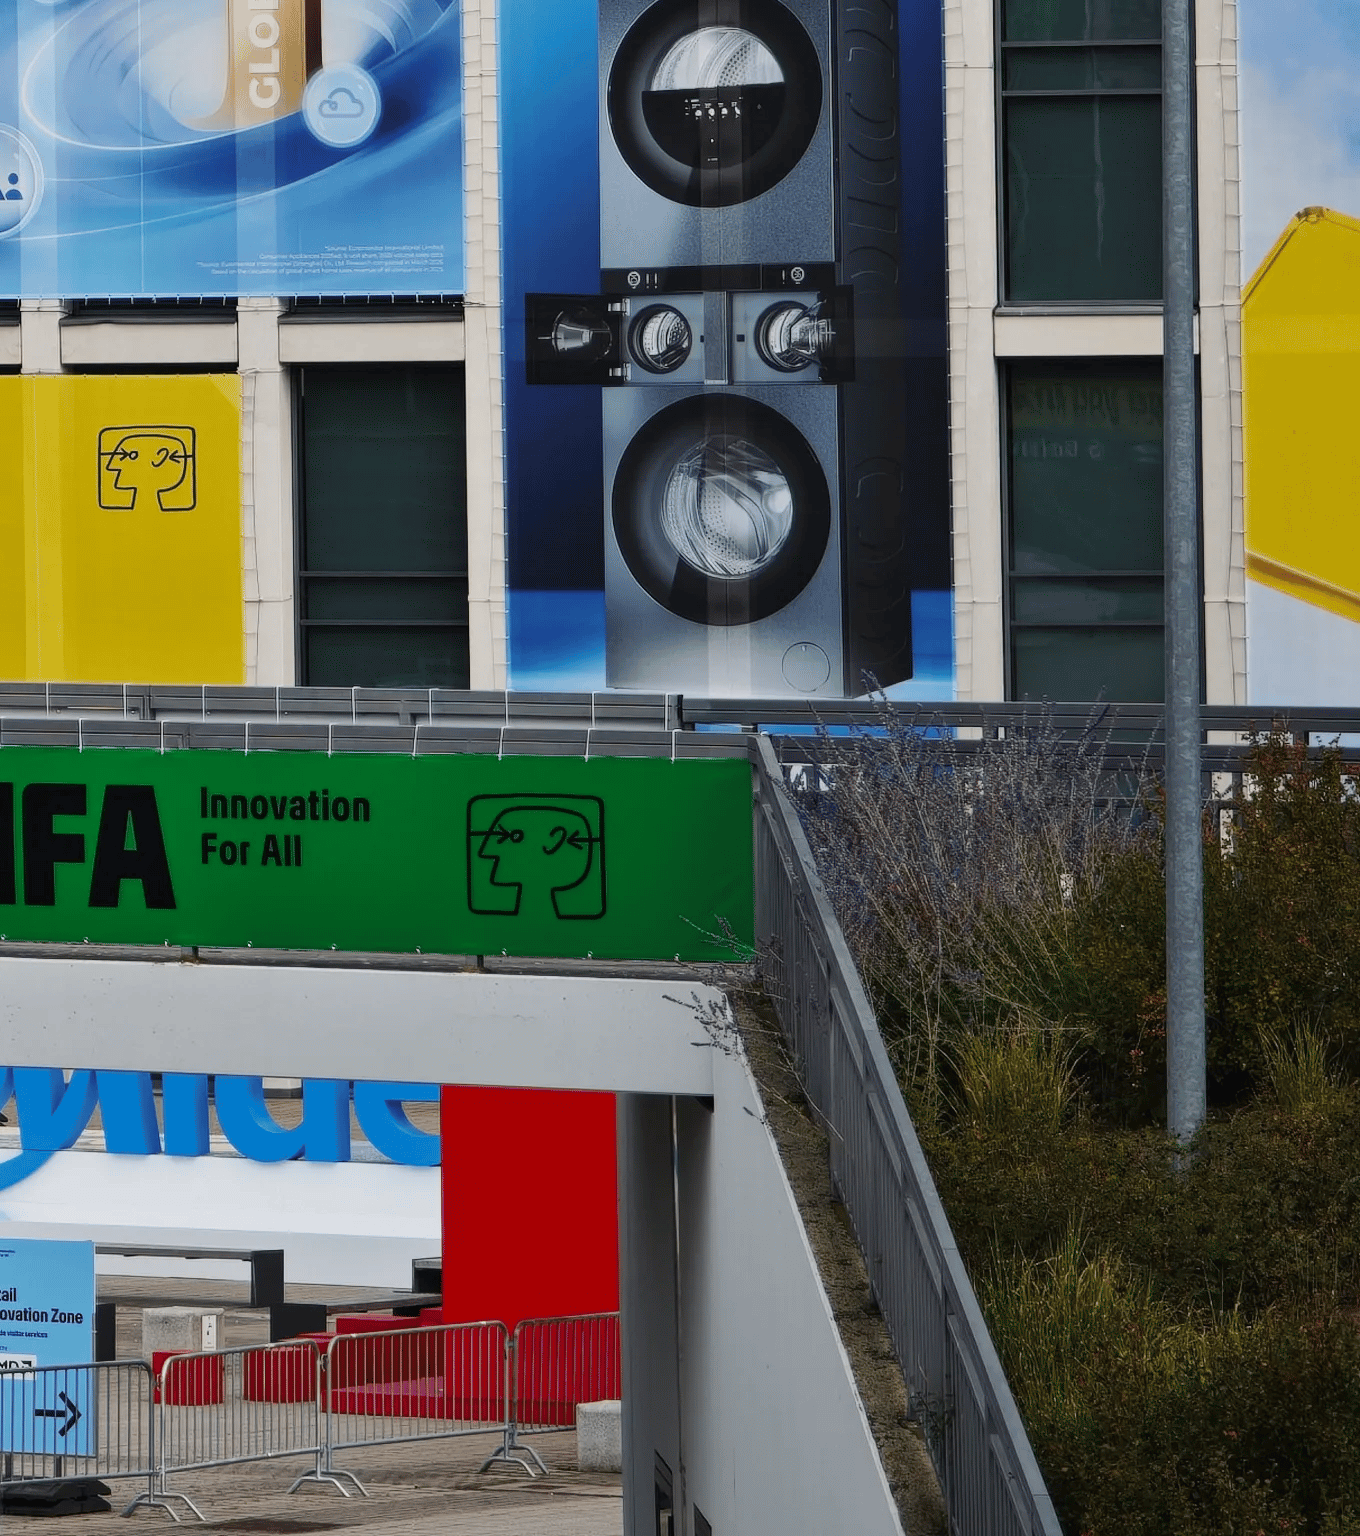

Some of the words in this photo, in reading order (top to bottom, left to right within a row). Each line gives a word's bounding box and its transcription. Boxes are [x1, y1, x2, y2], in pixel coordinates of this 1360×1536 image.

[200, 787, 371, 823] Innovation
[201, 832, 250, 866] For
[260, 833, 303, 868] All
[50, 1308, 84, 1325] Zone
